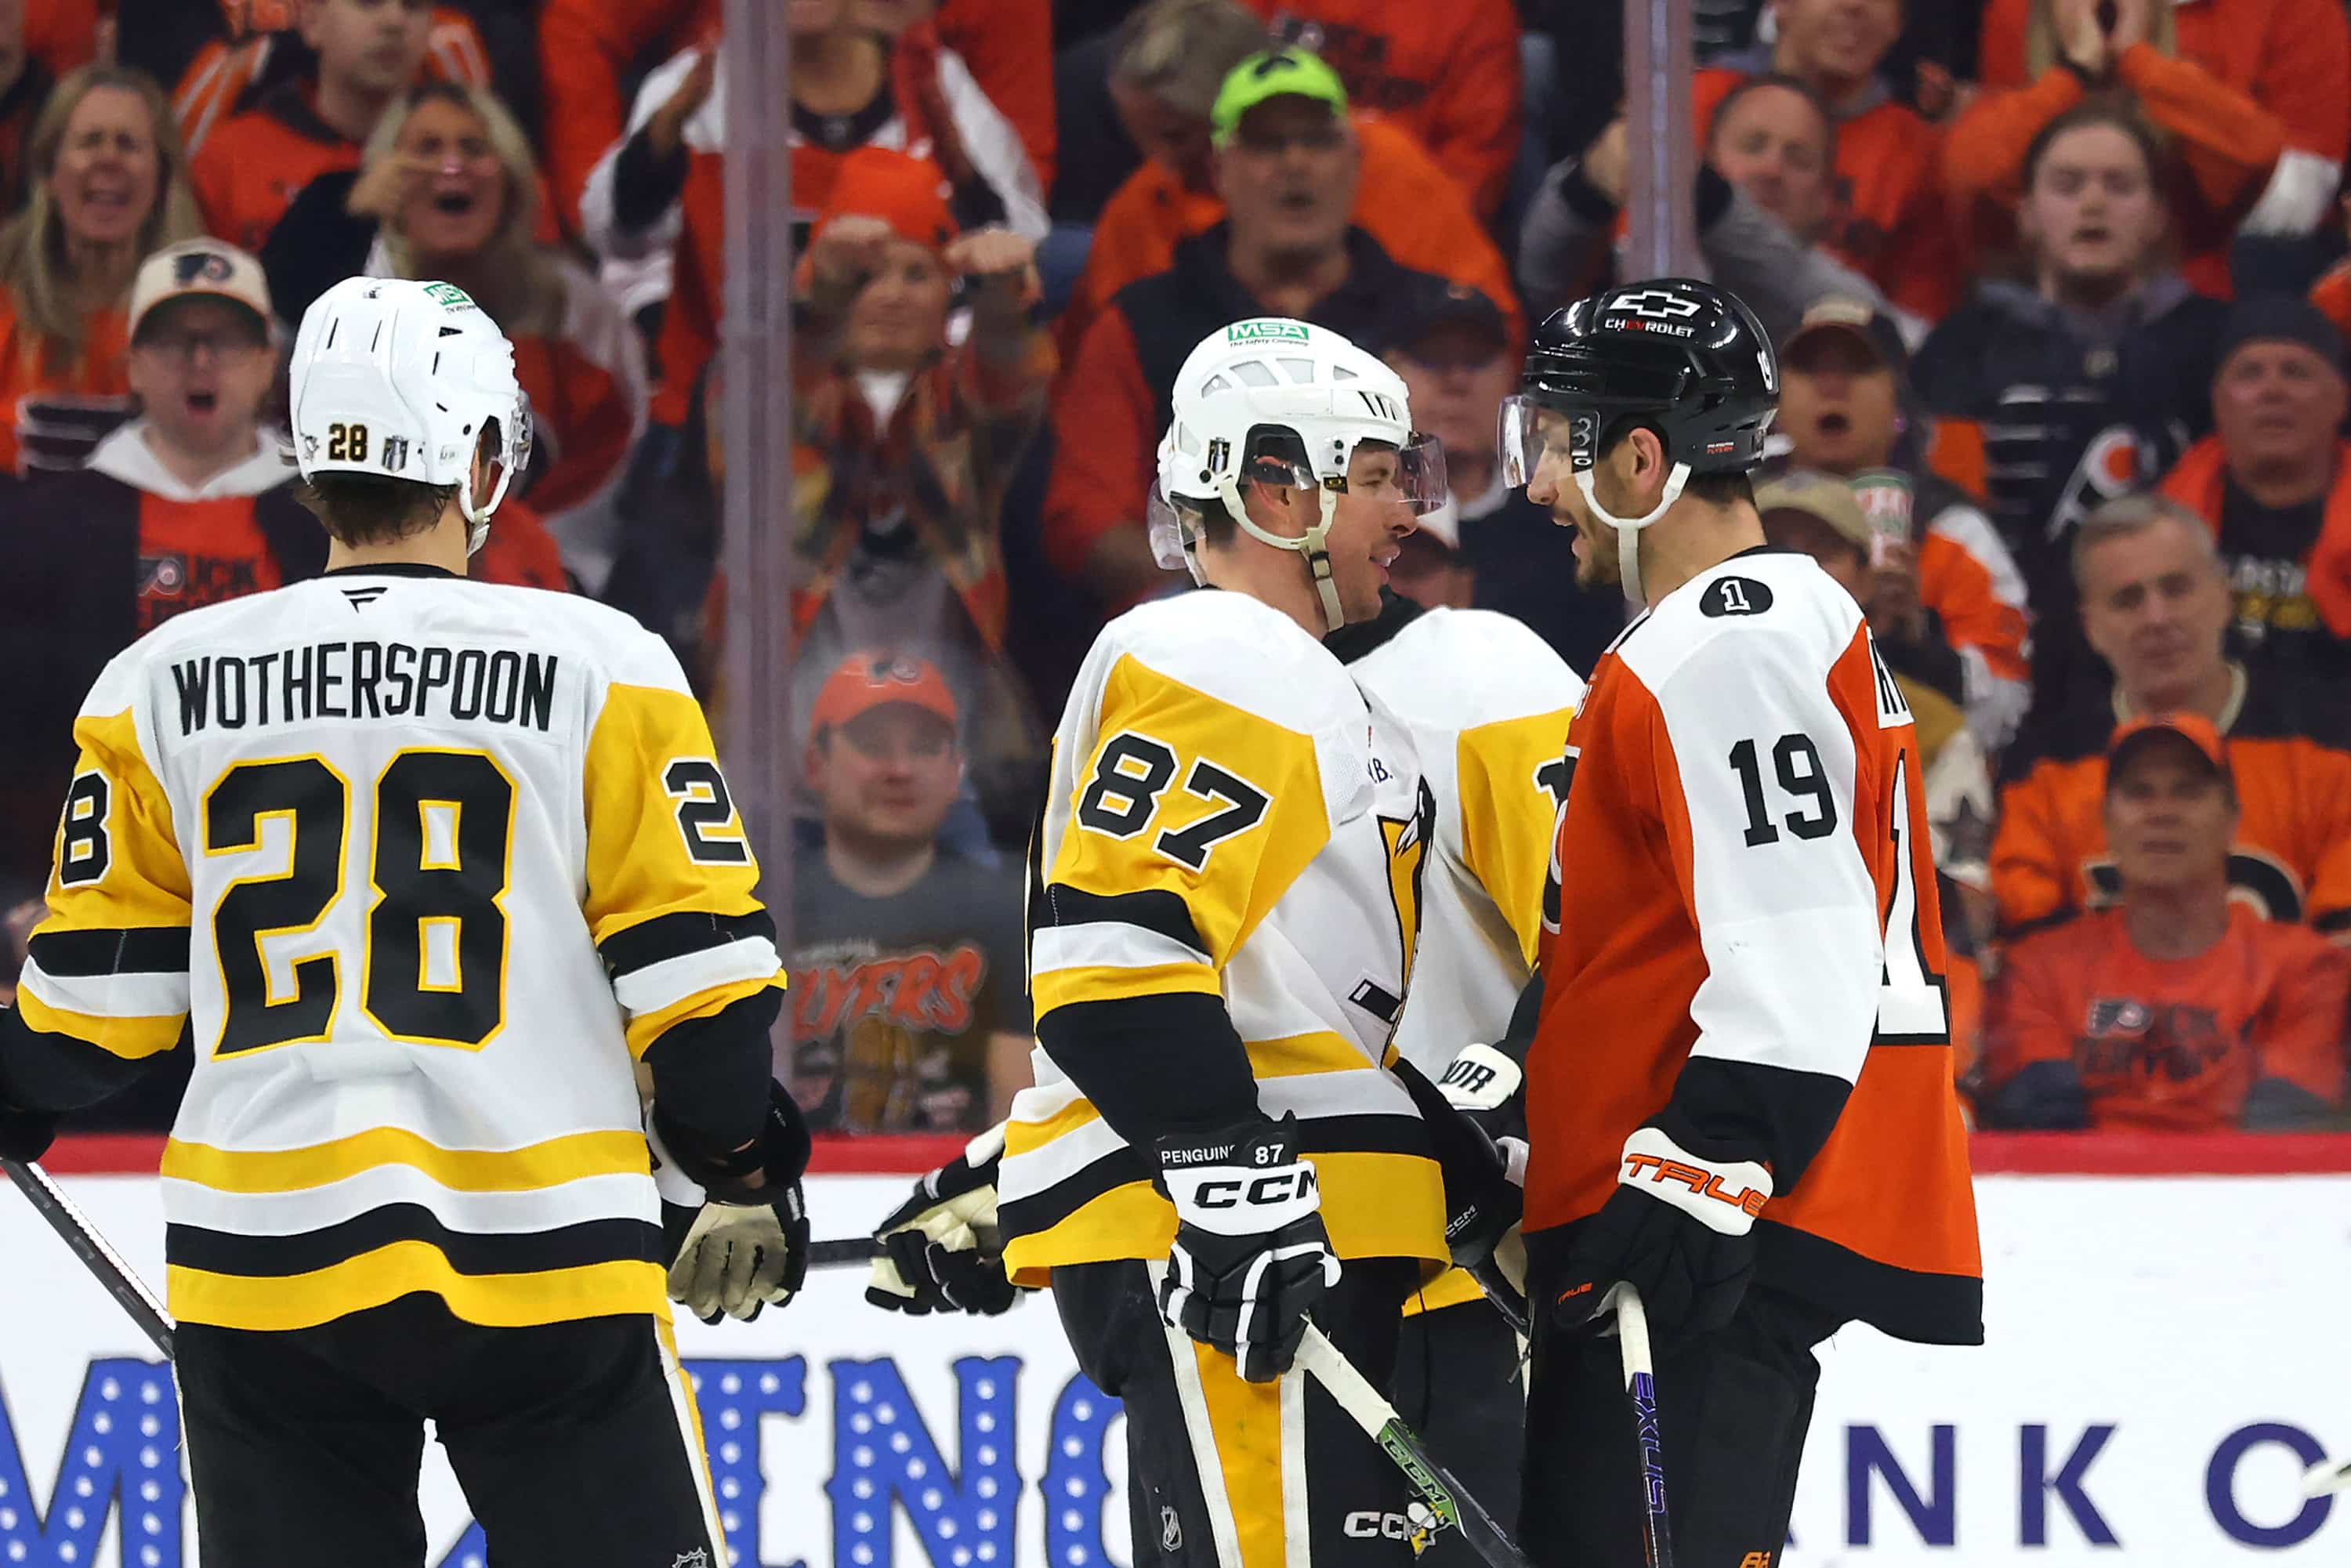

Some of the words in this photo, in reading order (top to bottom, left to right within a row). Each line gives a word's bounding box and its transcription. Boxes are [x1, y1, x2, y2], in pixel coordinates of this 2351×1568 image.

[1229, 322, 1309, 341] MSA
[1604, 318, 1695, 339] CHEVROLET
[328, 423, 368, 462] 28
[1721, 580, 1750, 611] 1
[171, 639, 559, 737] WOTHERSPOON
[1076, 729, 1274, 875] 87
[1729, 733, 1838, 848] 19
[58, 768, 113, 891] 8
[201, 745, 519, 1063] 28
[1255, 1143, 1284, 1164] 87
[1625, 1152, 1768, 1219] TRUE
[1192, 1170, 1320, 1209] CCM
[1557, 1282, 1593, 1305] TRUE
[1382, 1434, 1451, 1505] CCM
[1785, 1421, 2124, 1548] NK
